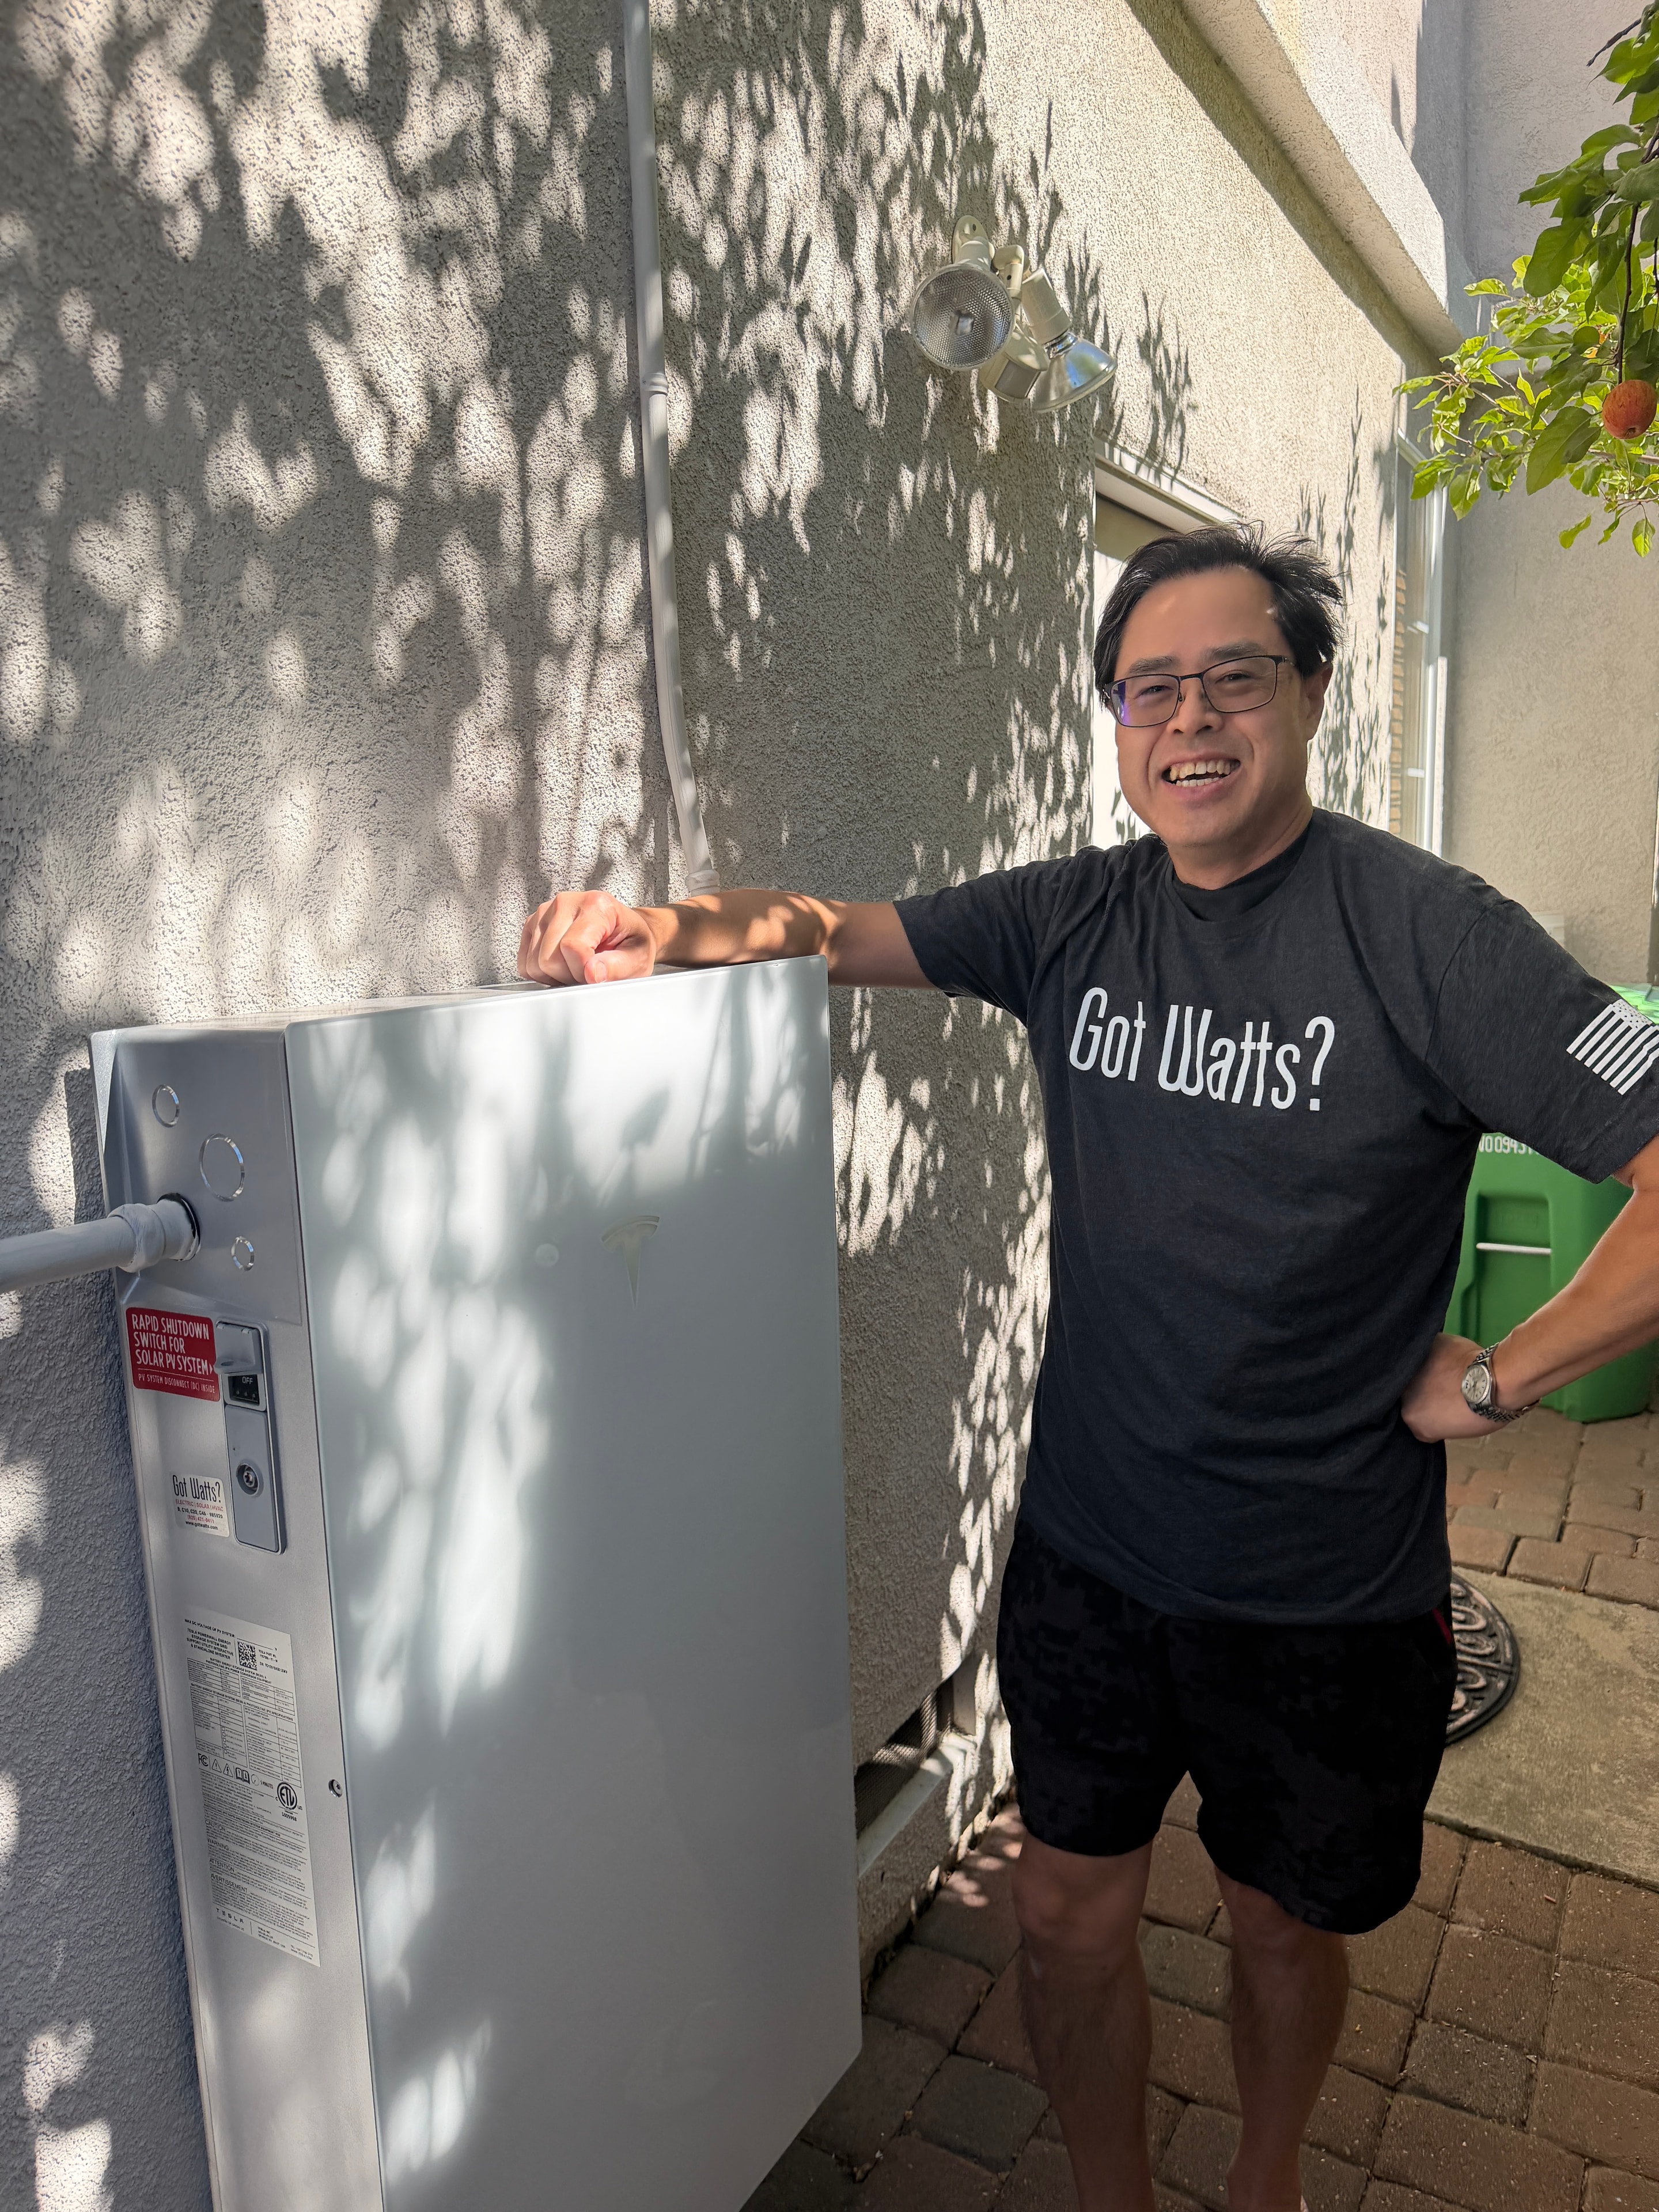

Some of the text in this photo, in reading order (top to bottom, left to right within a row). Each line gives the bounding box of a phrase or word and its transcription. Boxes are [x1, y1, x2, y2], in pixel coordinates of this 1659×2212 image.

[1069, 987, 1335, 1111] Got Watts?
[132, 1314, 209, 1340] RAPID SHUTDOWN
[134, 1332, 185, 1354] SWITCH FOR
[135, 1349, 209, 1376] SOLAR PV SYSTEM
[138, 1373, 215, 1393] PV SYSTEM DISCONNECT (DC) INSIDE
[242, 1376, 253, 1384] OFF
[173, 1475, 221, 1503] Got Watts?
